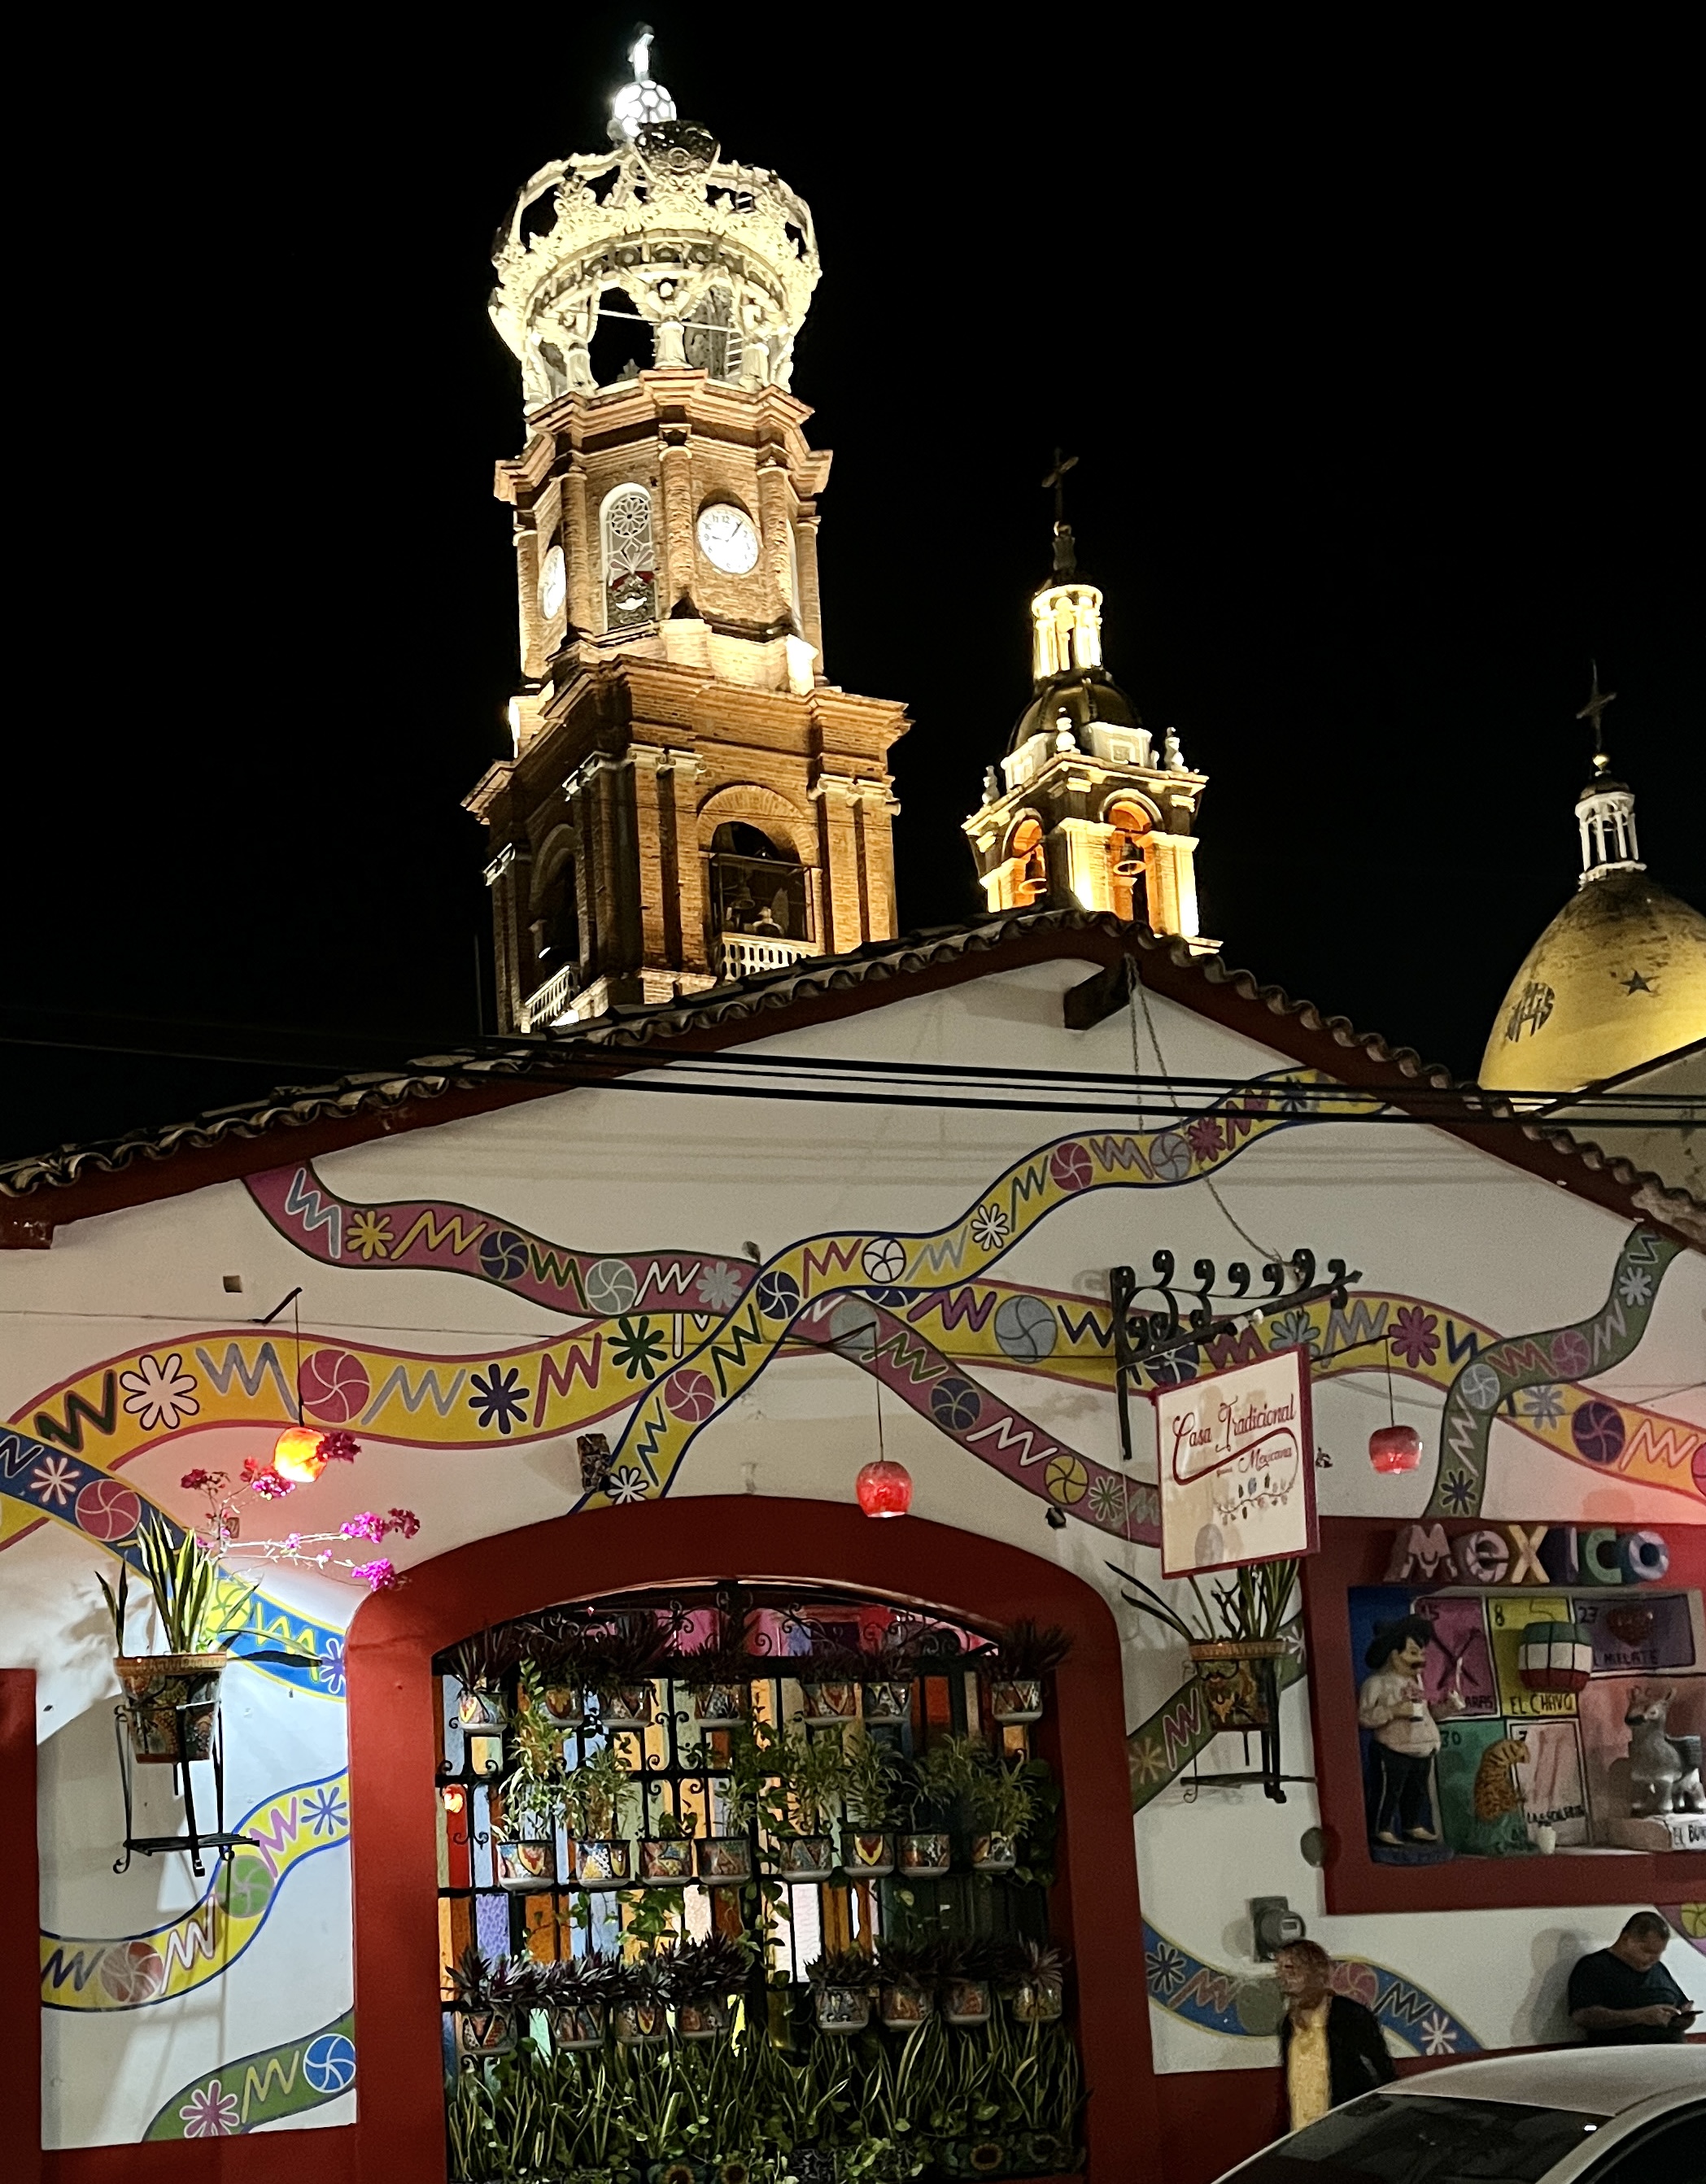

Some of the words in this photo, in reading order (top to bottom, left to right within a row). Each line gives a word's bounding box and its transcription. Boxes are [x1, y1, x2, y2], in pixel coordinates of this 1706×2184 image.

[1172, 1411, 1211, 1456] Casa
[1215, 1393, 1295, 1452] Tradicional
[1237, 1446, 1293, 1473] Mexicana
[1494, 1604, 1505, 1627] 8
[1510, 1695, 1528, 1715] EL
